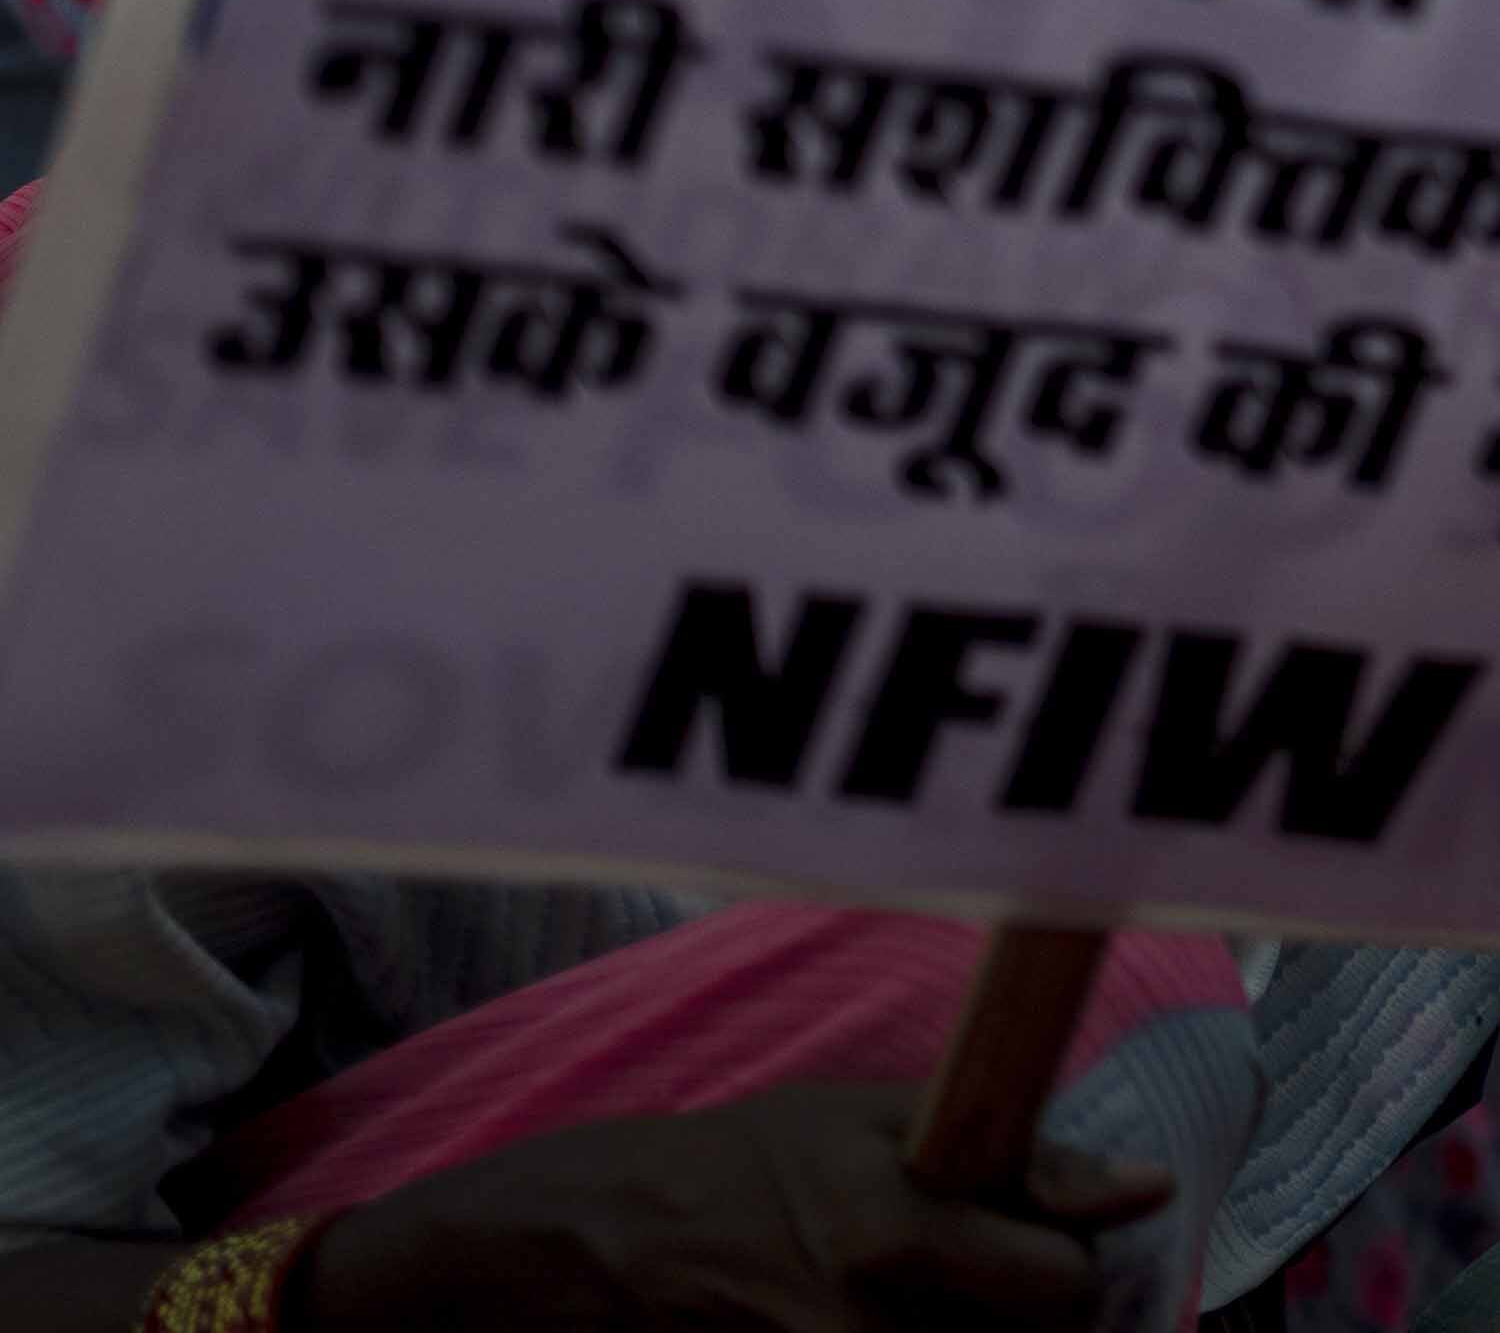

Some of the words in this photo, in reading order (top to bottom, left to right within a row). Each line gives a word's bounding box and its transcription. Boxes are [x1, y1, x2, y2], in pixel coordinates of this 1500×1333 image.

[208, 219, 684, 397] उसके
[710, 281, 1178, 505] वजूद
[1186, 315, 1448, 490] की
[611, 578, 1487, 848] NFIW
